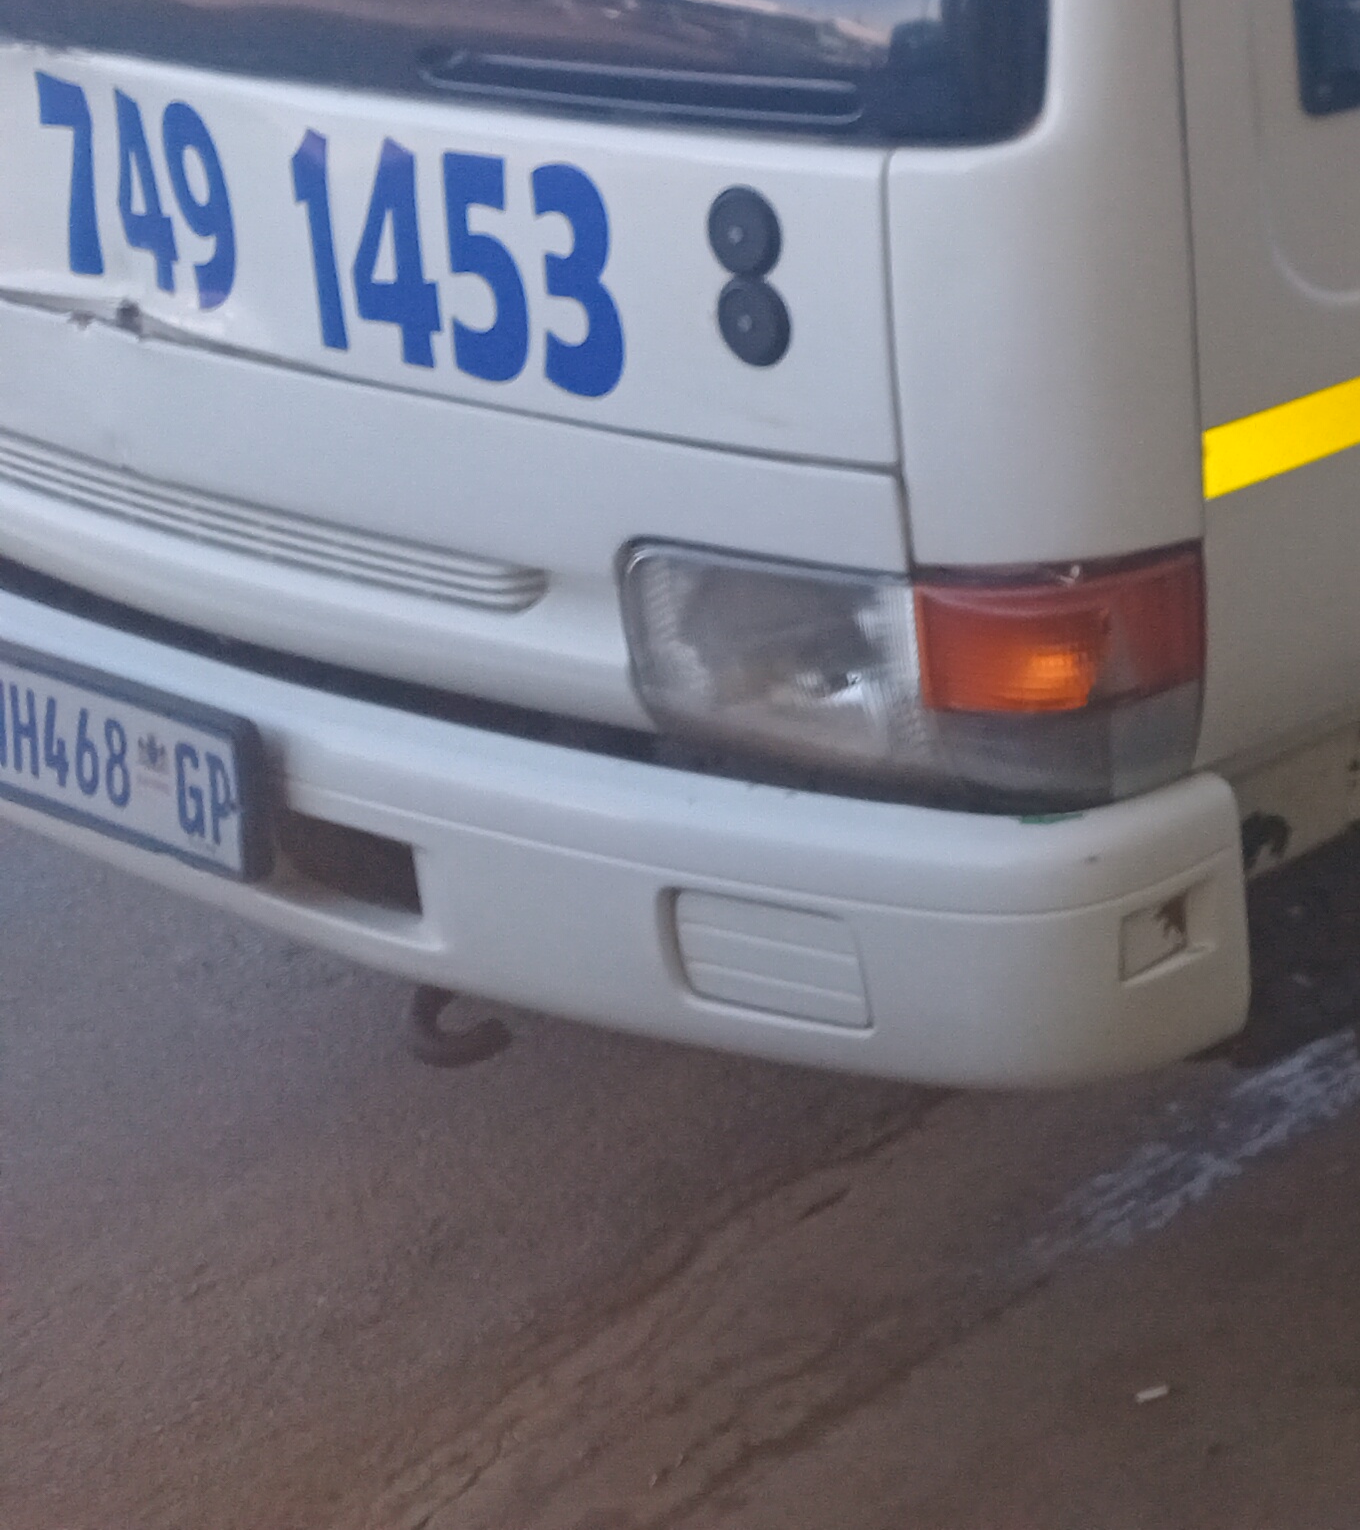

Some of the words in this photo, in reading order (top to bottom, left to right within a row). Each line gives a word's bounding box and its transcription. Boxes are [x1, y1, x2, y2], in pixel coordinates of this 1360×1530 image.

[35, 71, 237, 310] 749
[291, 128, 625, 398] 1453
[0, 677, 131, 808] H468
[174, 740, 233, 846] GP
